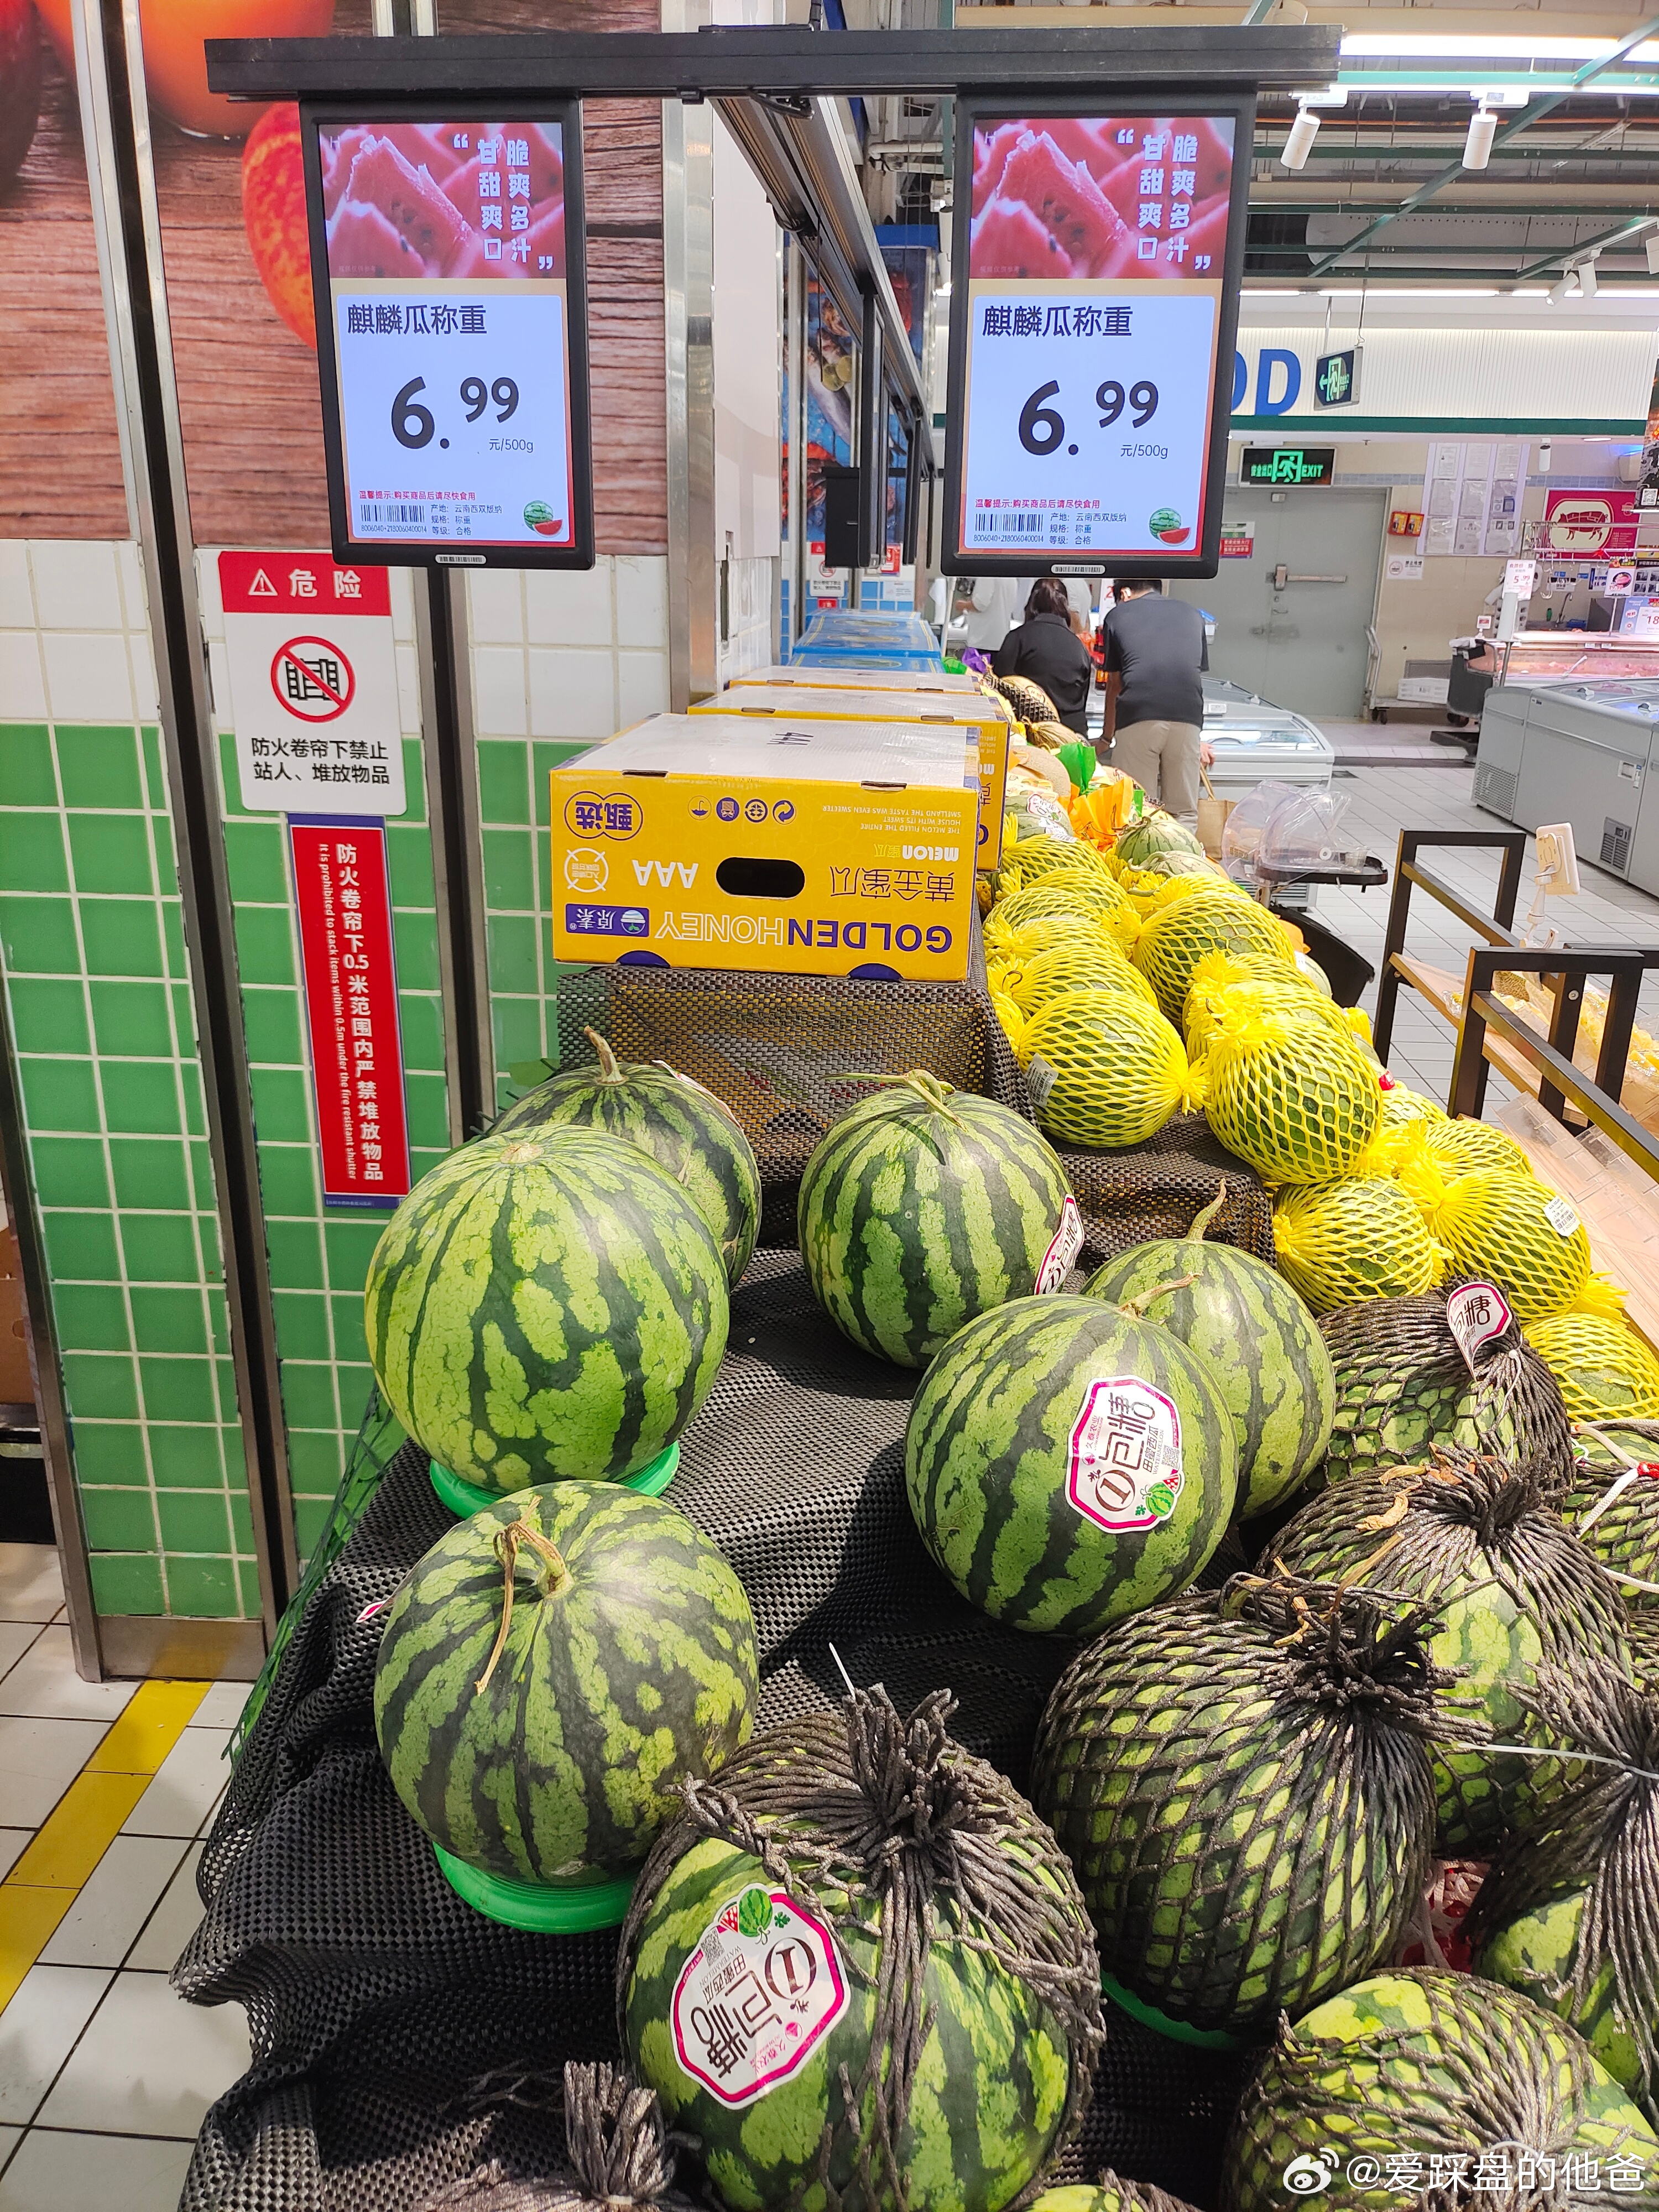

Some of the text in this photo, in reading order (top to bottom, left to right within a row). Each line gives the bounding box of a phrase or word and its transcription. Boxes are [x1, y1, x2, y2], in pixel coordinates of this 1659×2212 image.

[477, 140, 502, 260] 甘甜爽口
[507, 140, 531, 263] 脆爽多汁
[1138, 134, 1166, 260] 甘甜爽口
[1167, 134, 1197, 263] 脆爽多汁
[348, 304, 487, 335] 麒麟瓜称重
[982, 305, 1133, 337] 麒麟瓜称重
[488, 437, 534, 453] 元/500g
[1120, 443, 1168, 458] 元/500g
[1301, 464, 1323, 477] EXIT
[455, 505, 502, 514] 云南西双版纳
[455, 515, 471, 525] 称重
[1076, 513, 1126, 522] 云南西双版纳
[456, 527, 471, 536] 合格
[1074, 536, 1091, 545] 合格
[1075, 525, 1092, 533] 称重
[289, 569, 362, 598] 危险
[252, 738, 389, 760] 防火卷帘下禁止
[254, 761, 390, 784] 站人、堆放物品
[575, 801, 633, 831] 甄选
[874, 844, 901, 858] 蜜瓜
[632, 860, 698, 889] AAA
[830, 866, 955, 902] 黄金蜜瓜
[654, 911, 952, 953] GOLDEN HONEY
[319, 844, 357, 1180] It is prohibited to stack items within 0.5m under the fire resistant shutter
[336, 843, 384, 1181] 防火卷帘下0.5米范围内严禁堆放物品
[1143, 1425, 1159, 1472] 田蜜西瓜
[1152, 1430, 1164, 1475] WATERMELON
[700, 1946, 742, 1986] WATERMELON
[702, 1954, 745, 2005] 田蜜西瓜
